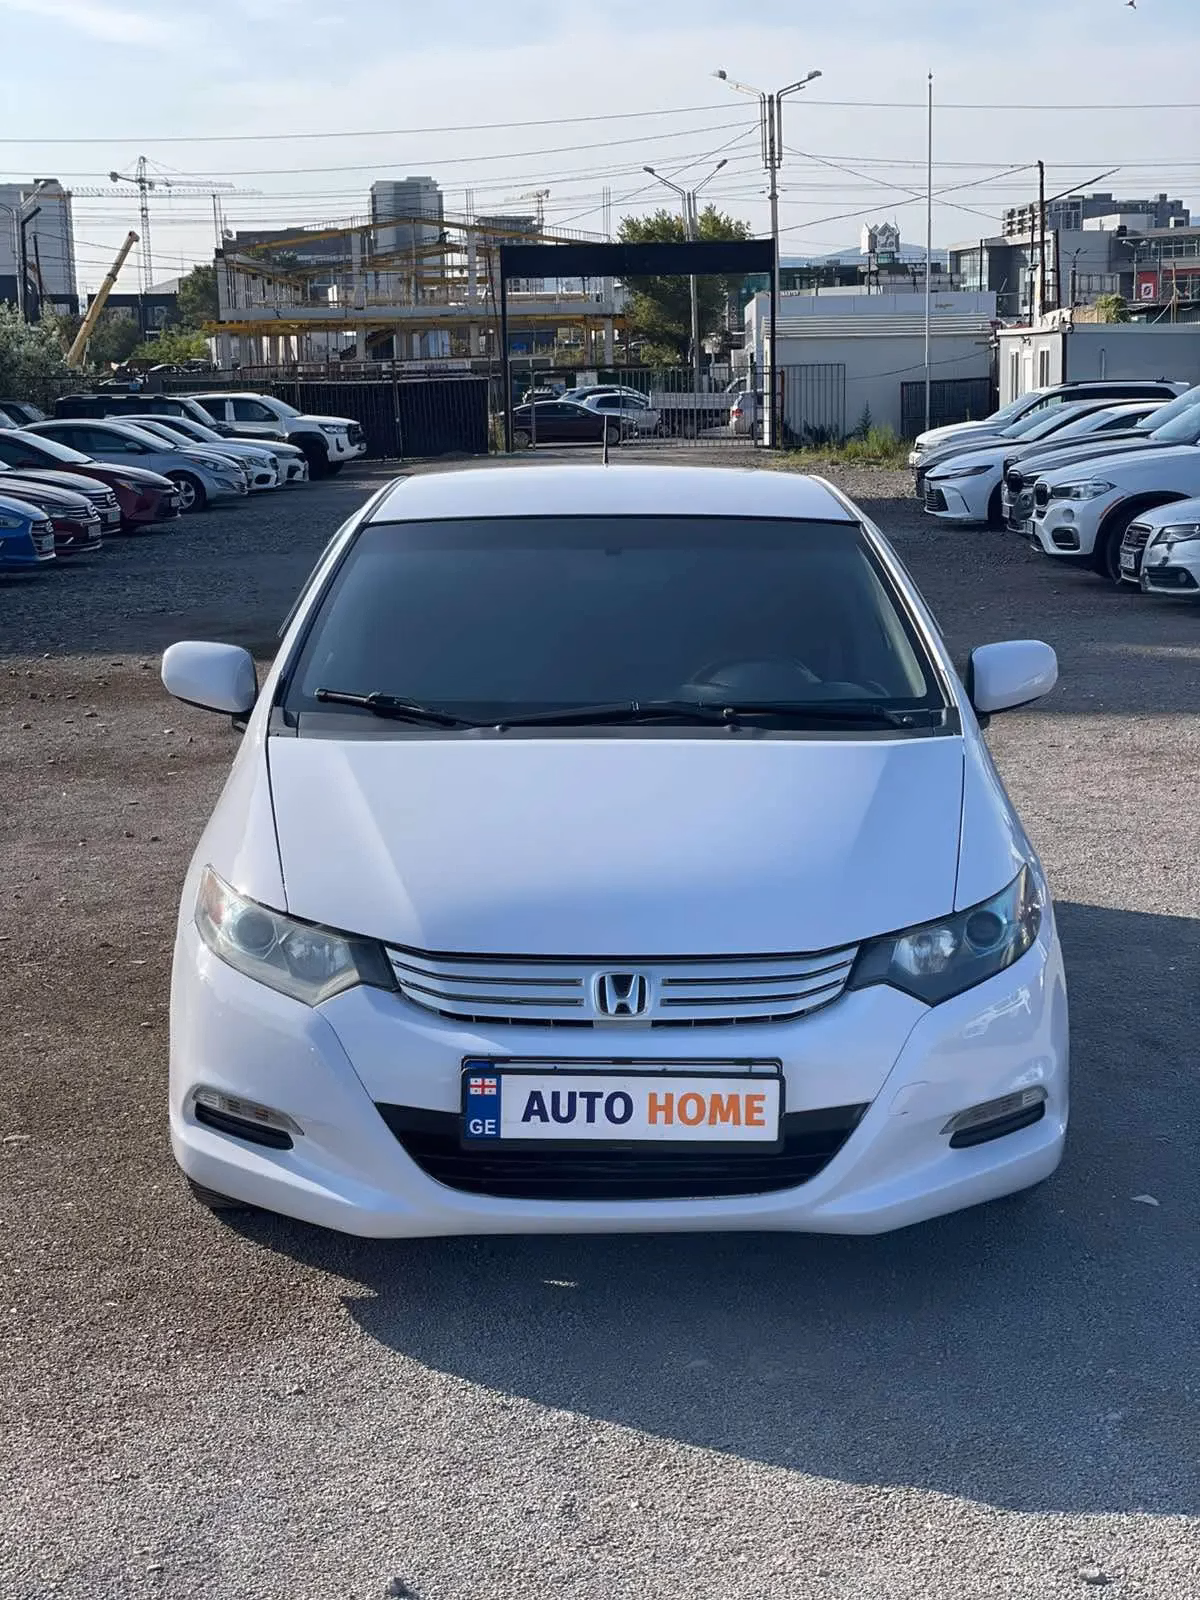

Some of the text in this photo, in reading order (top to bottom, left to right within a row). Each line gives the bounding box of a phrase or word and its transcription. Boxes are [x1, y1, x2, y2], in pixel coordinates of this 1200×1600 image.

[521, 1090, 766, 1127] AUTO HOME
[469, 1119, 497, 1135] GE
